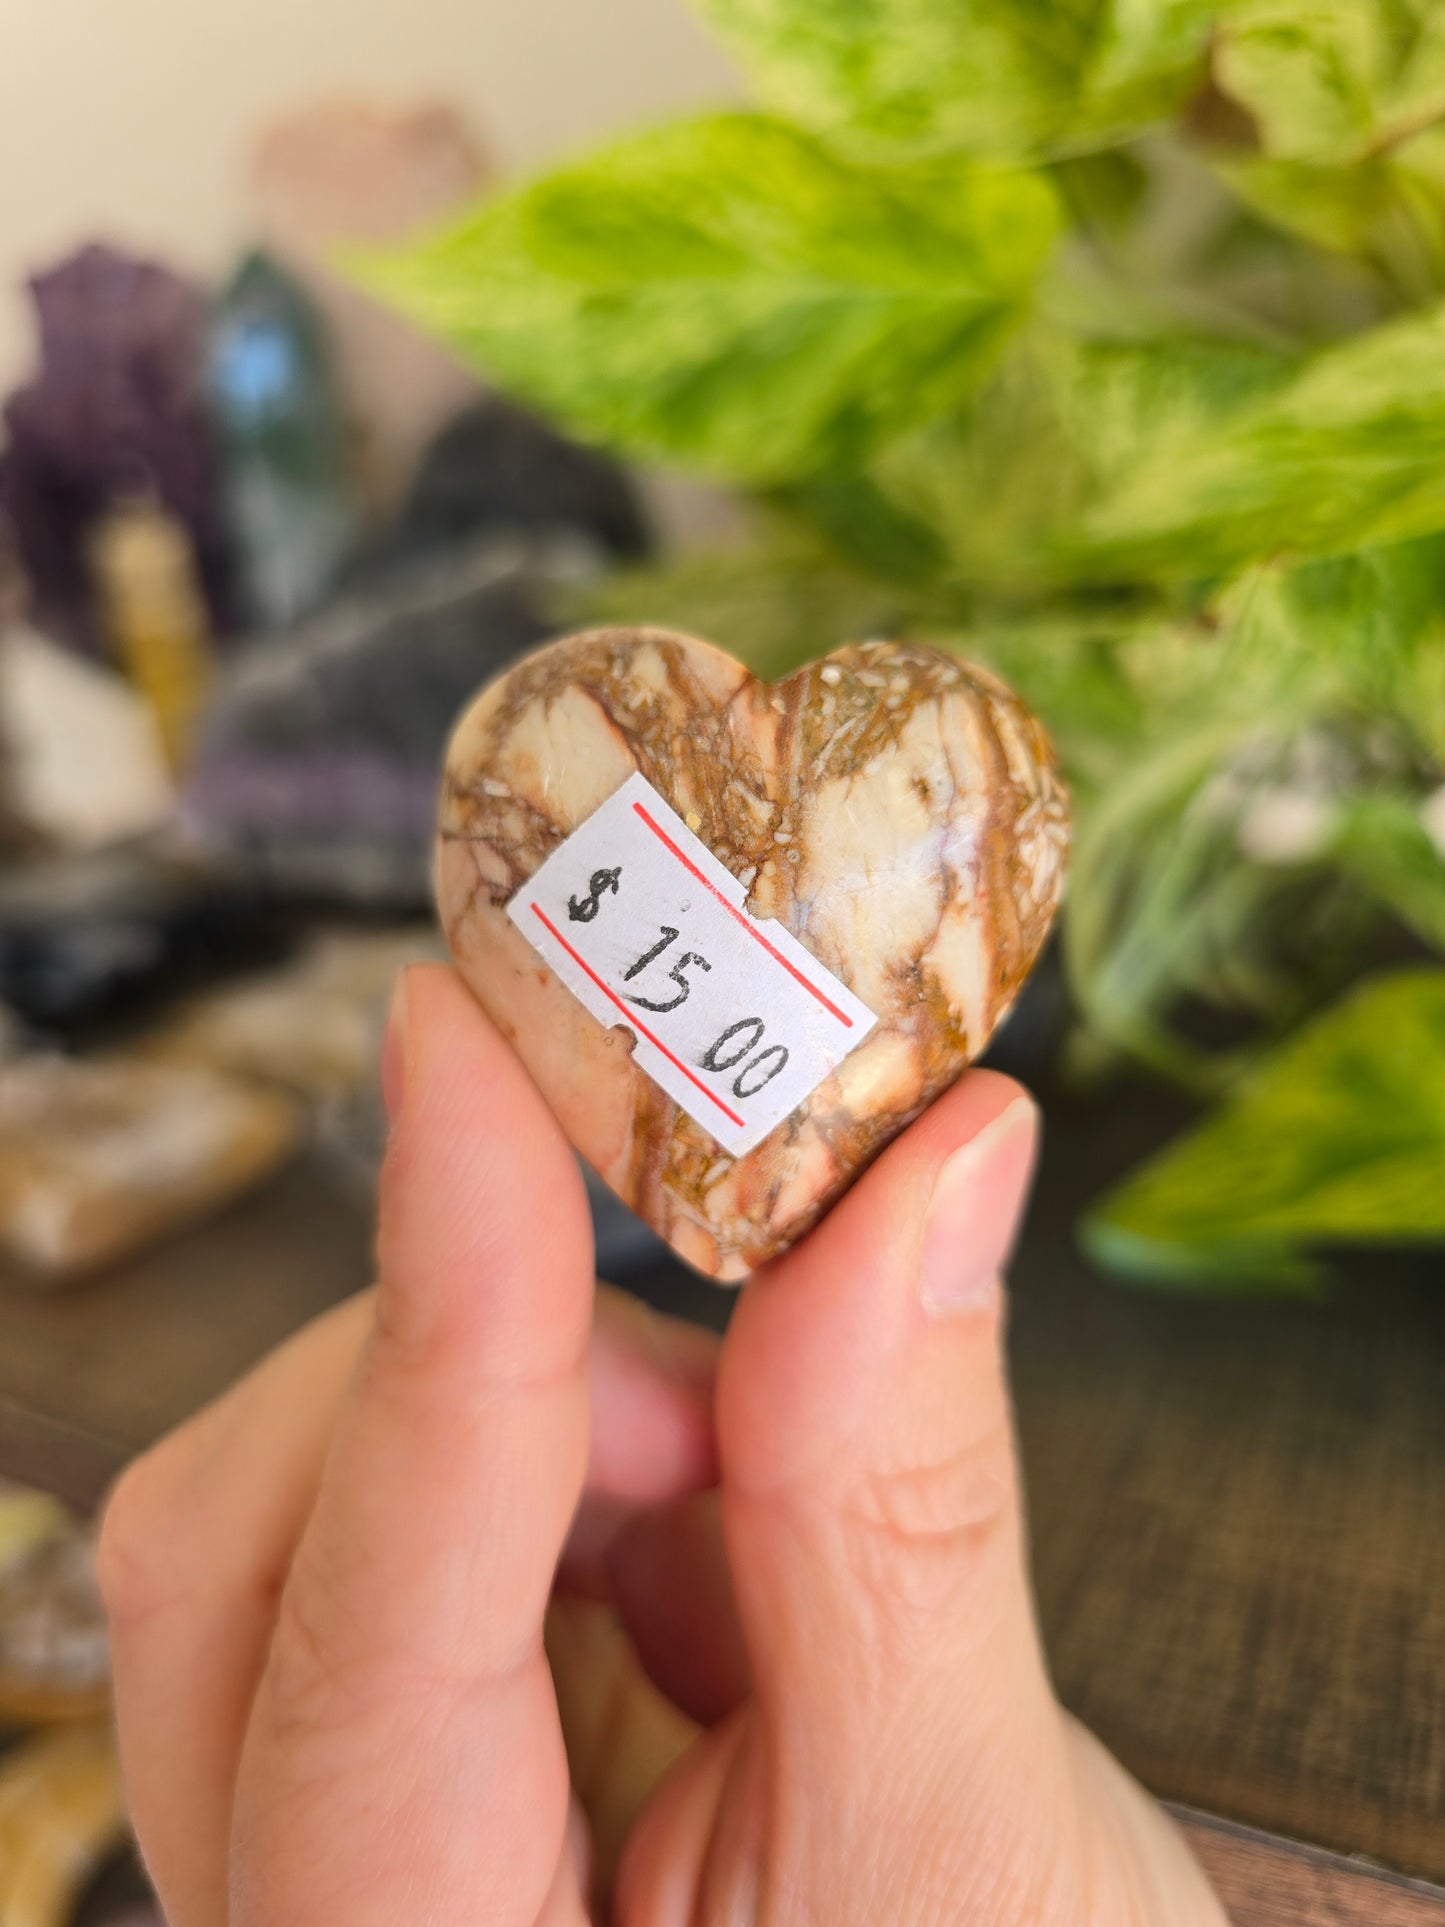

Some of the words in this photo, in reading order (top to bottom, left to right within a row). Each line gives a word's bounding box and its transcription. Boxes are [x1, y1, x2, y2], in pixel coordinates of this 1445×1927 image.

[567, 866, 623, 923] $
[622, 925, 713, 1013] 15
[700, 1016, 790, 1099] 00
